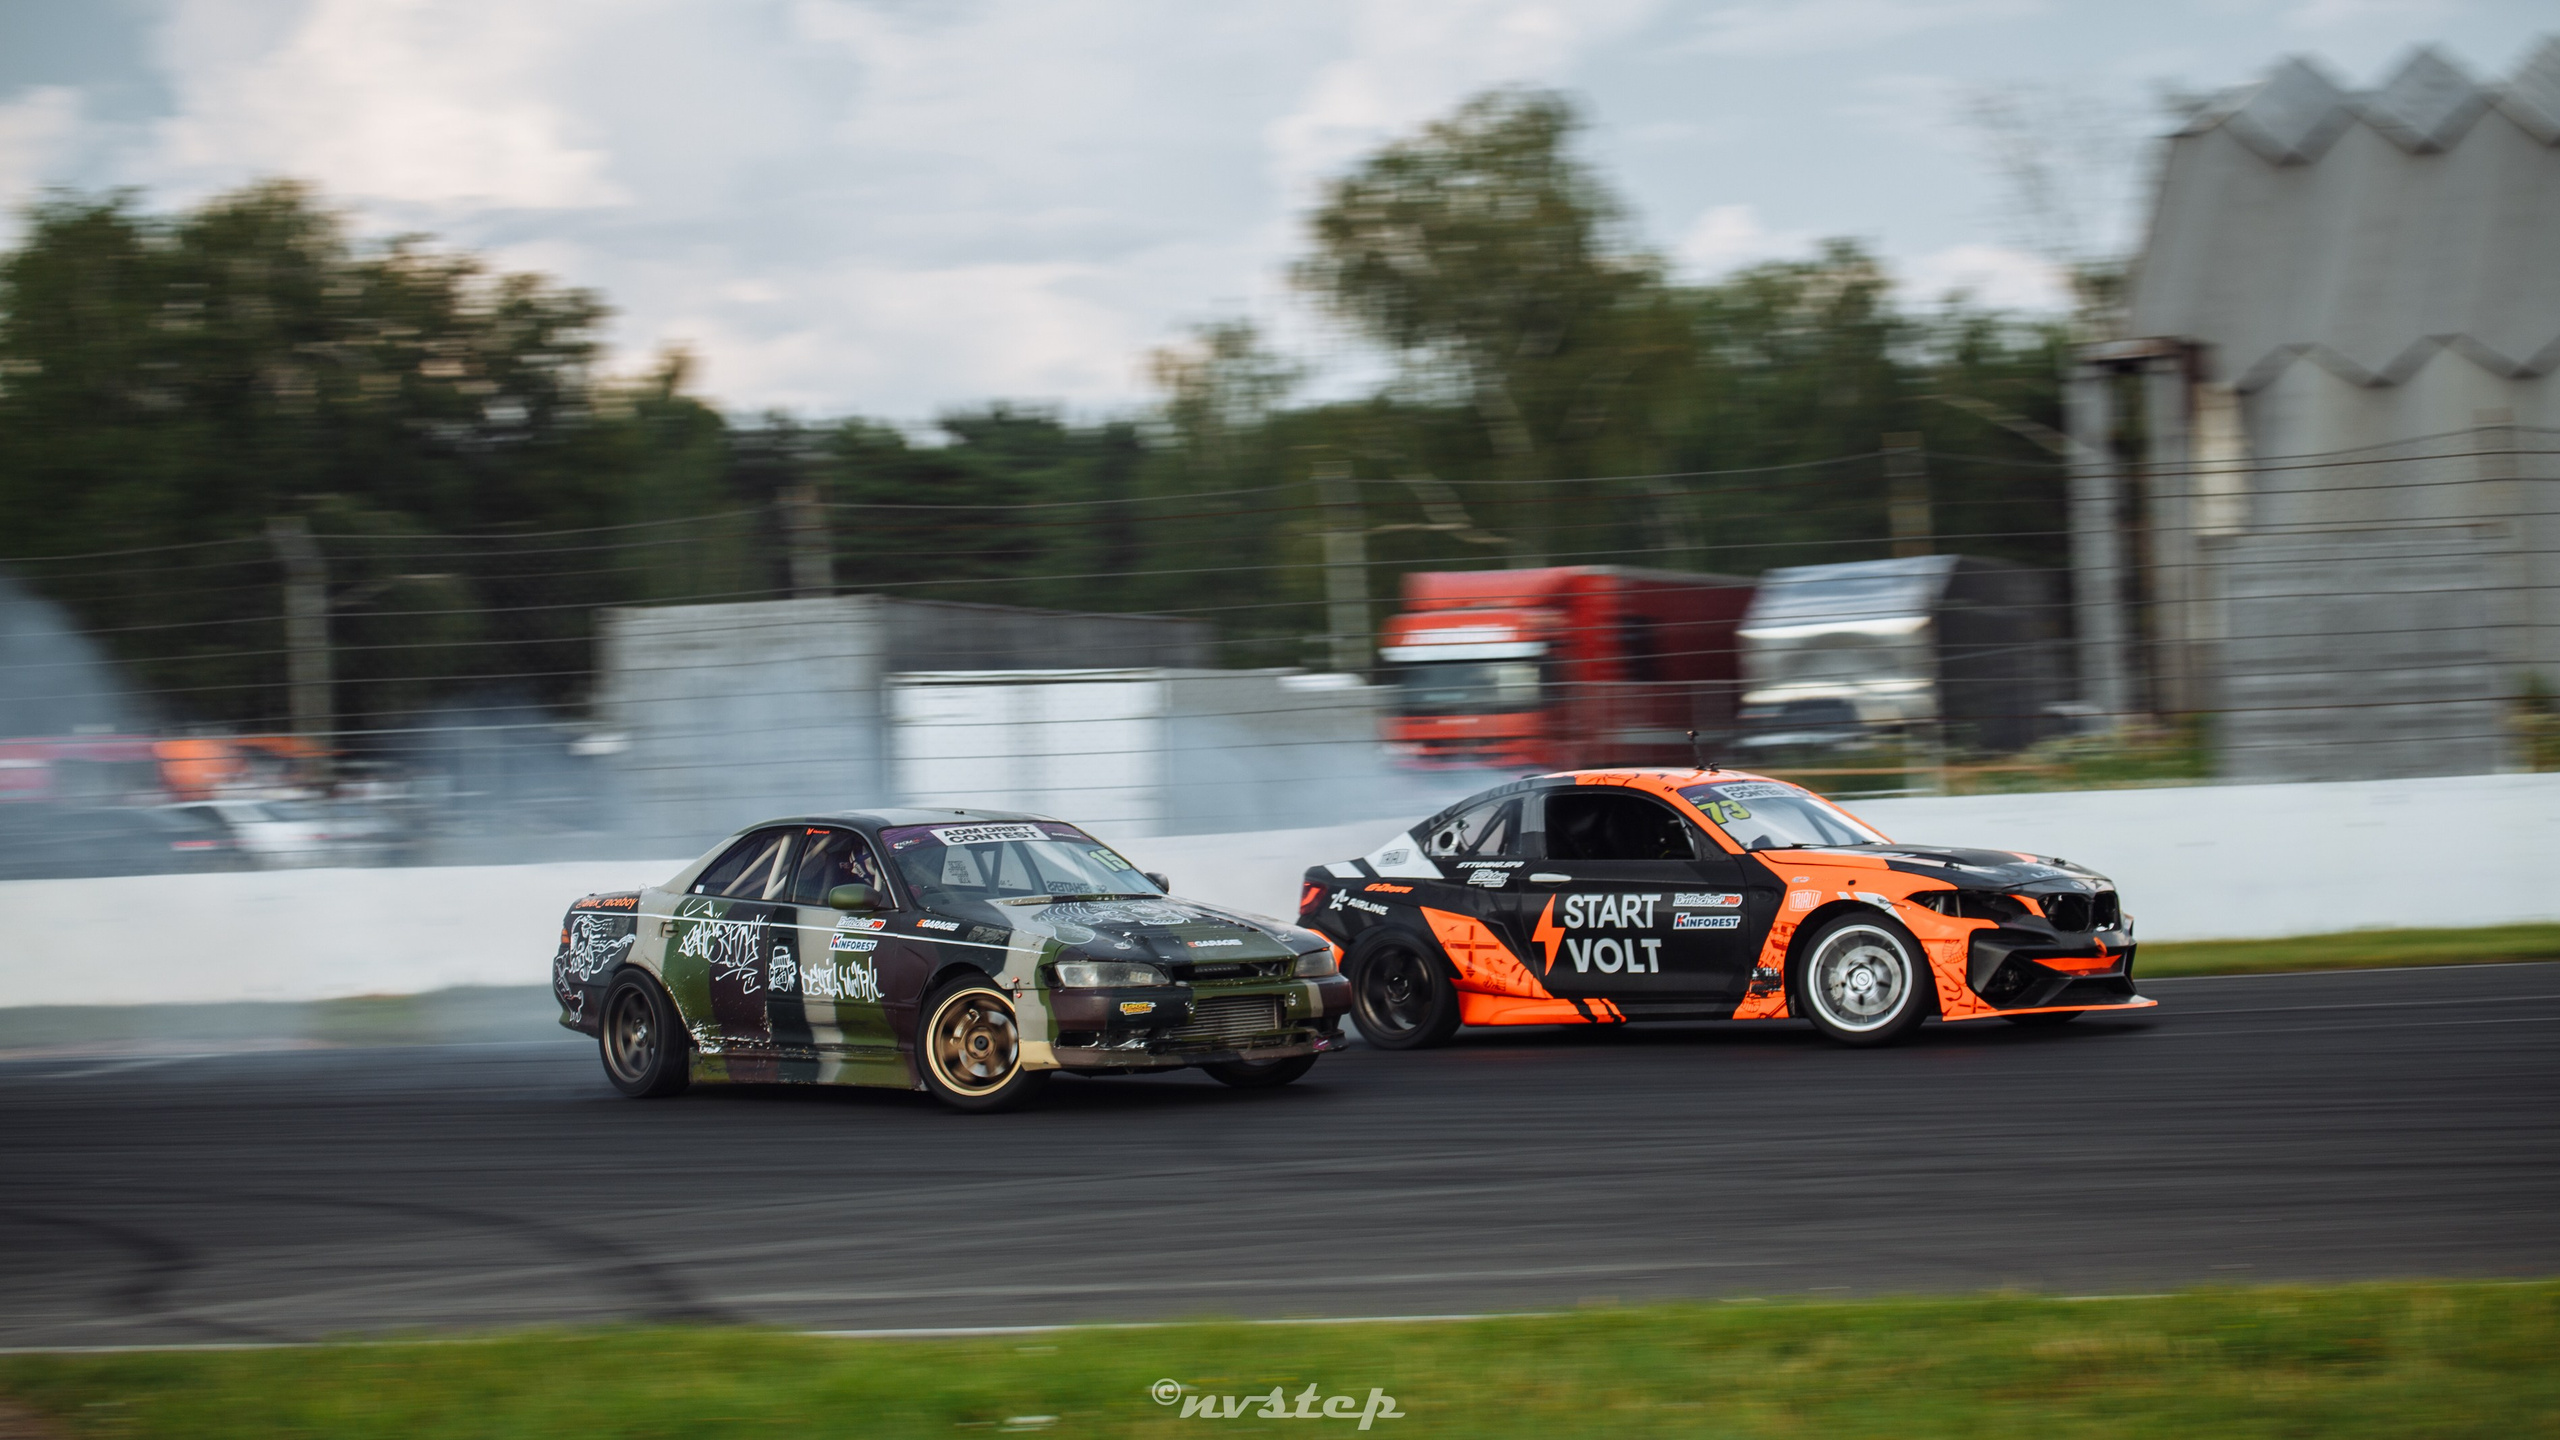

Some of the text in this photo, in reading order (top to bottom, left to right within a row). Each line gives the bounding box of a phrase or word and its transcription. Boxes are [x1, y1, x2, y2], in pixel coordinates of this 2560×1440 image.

[1697, 800, 1752, 825] 73
[943, 826, 1031, 837] ADM DRIFT
[948, 831, 1038, 843] CONTEST
[1087, 848, 1132, 873] 15
[1347, 897, 1389, 915] AIRLINE
[1791, 890, 1820, 909] TRIALLI
[1564, 894, 1662, 929] START
[1676, 914, 1739, 927] KINFOREST
[831, 935, 876, 950] KINFOREST
[1566, 937, 1662, 974] VOLT
